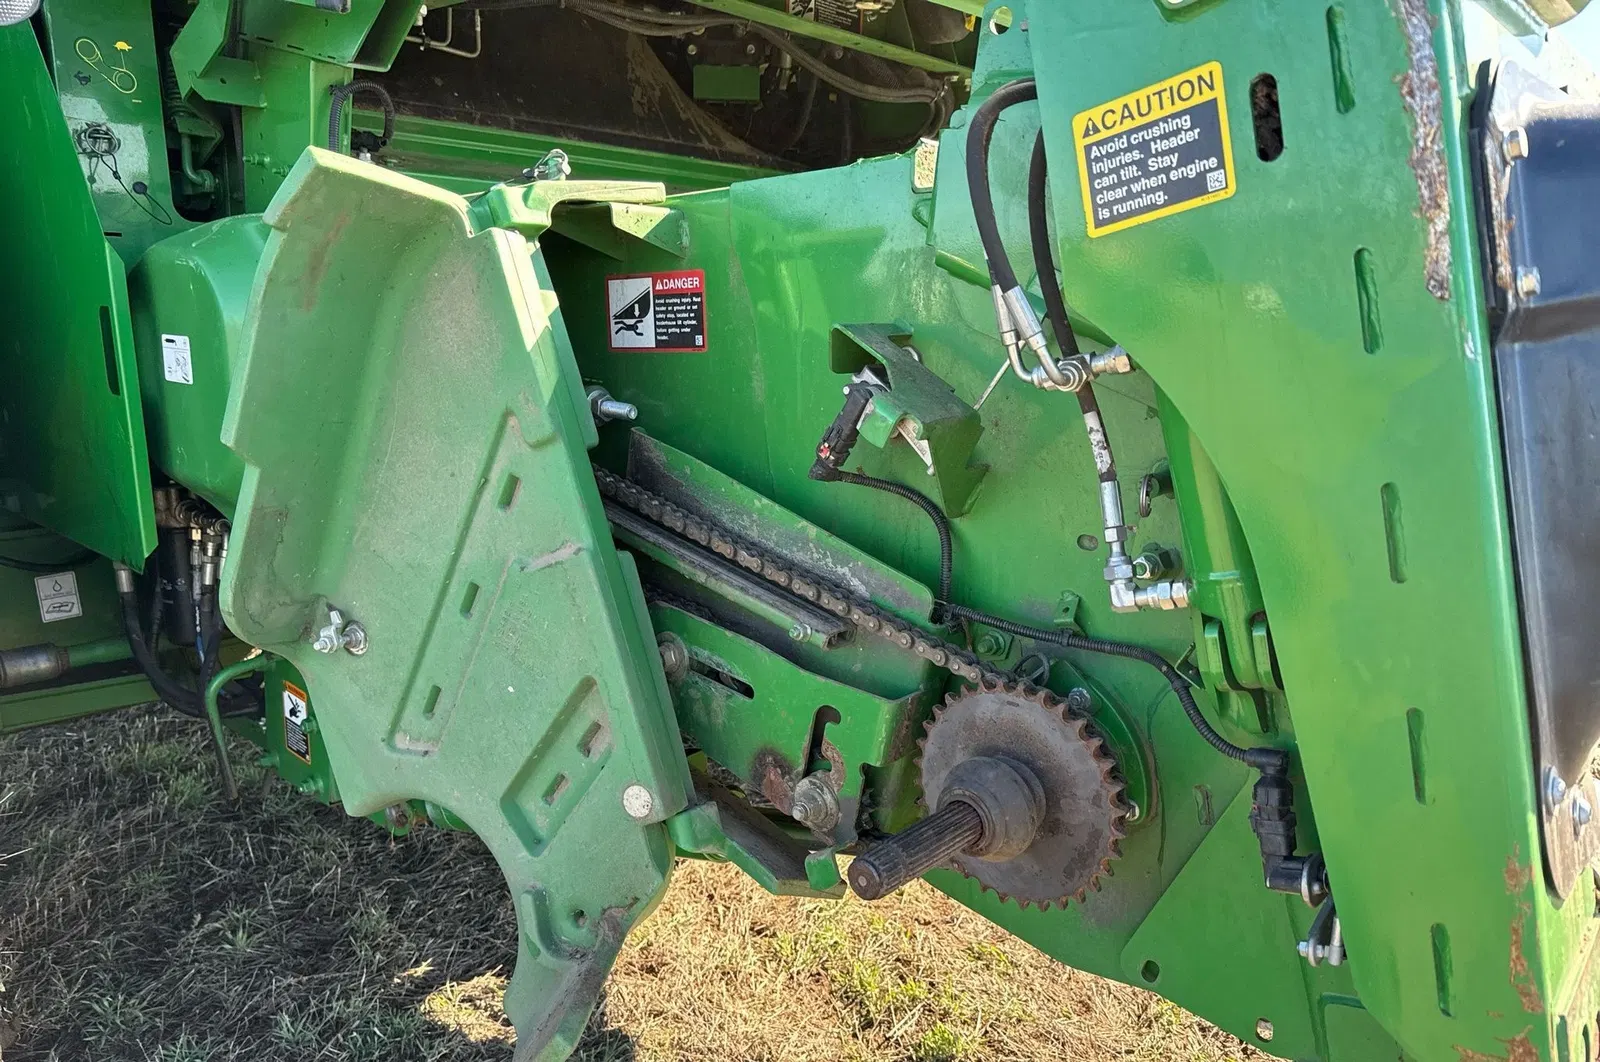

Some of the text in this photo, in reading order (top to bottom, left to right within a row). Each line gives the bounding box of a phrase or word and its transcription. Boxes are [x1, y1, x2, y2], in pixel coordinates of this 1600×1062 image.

[1101, 71, 1215, 130] CAUTION
[1090, 115, 1191, 159] Avoid crushing
[1092, 128, 1200, 174] injuries. Header
[1094, 153, 1178, 189] can tilt. Stay
[1096, 157, 1218, 204] clear when engine
[1098, 190, 1168, 220] is running.
[663, 277, 700, 290] DANGER
